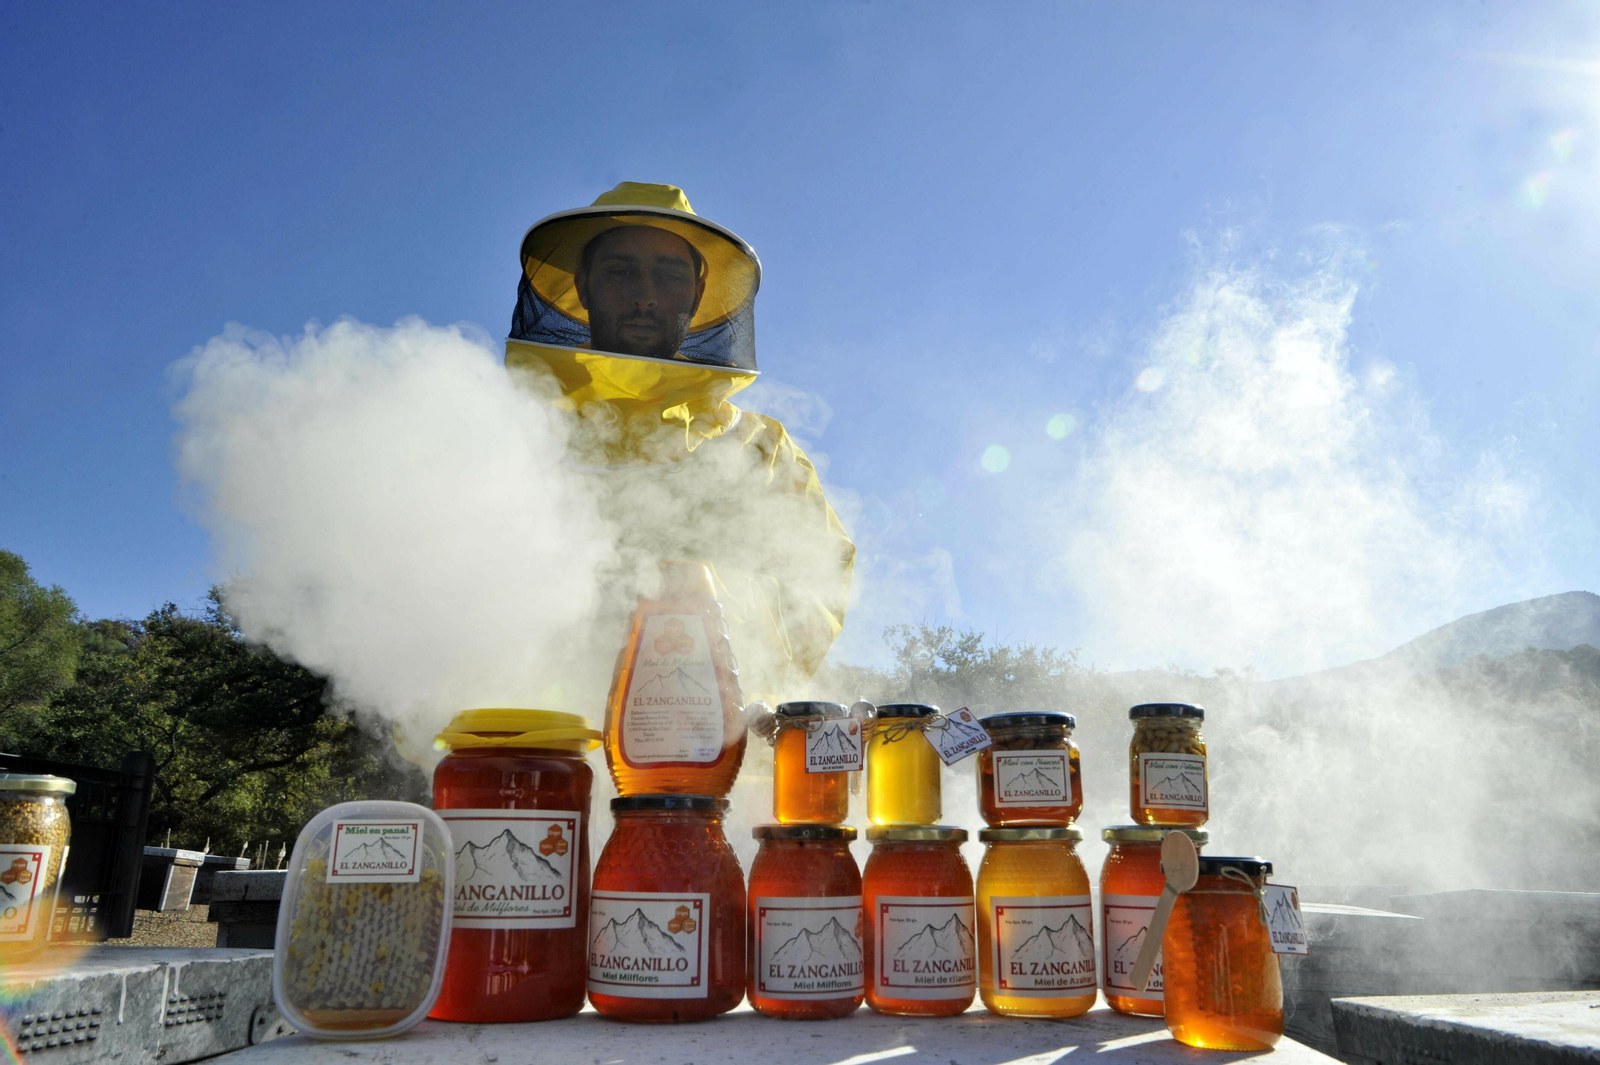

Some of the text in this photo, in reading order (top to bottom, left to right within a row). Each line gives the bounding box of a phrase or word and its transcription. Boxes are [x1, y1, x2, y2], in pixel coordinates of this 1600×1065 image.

[634, 696, 712, 707] EL ZANGANILLO
[944, 750, 952, 758] EL
[951, 733, 987, 756] ZANGANILLO
[810, 754, 858, 766] EL ZANGANILLO
[1001, 758, 1018, 766] Miel
[1035, 758, 1061, 766] Nueces
[1014, 789, 1061, 797] ZANGANILLO
[1159, 793, 1202, 802] ZANGANILLO
[382, 826, 409, 835] panal
[352, 861, 408, 870] ZANGANILLO
[467, 902, 480, 912] de
[481, 902, 530, 915] Milflores
[591, 953, 689, 972] EL ZANGANILLO
[893, 959, 909, 973] EL
[1010, 959, 1095, 976] EL ZANGANILL
[1114, 960, 1127, 974] EL
[769, 960, 863, 978] EL ZANGANILLO
[602, 972, 659, 983] Miel Milflores
[915, 976, 935, 984] Miel
[1034, 978, 1055, 986] Miel
[817, 980, 852, 989] Milflores
